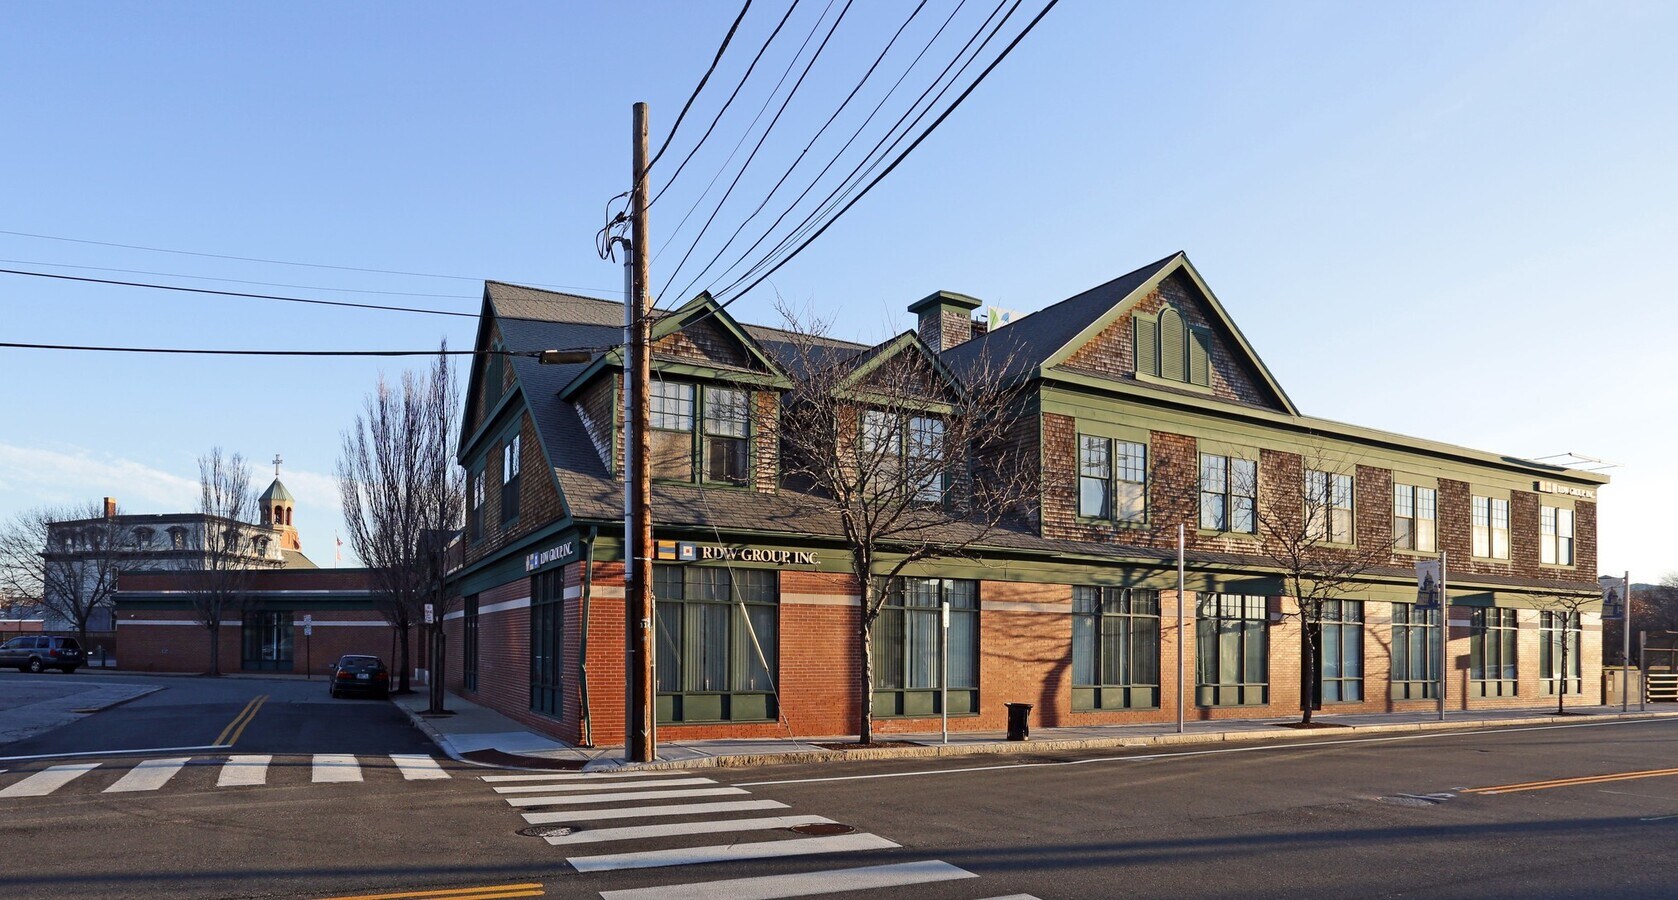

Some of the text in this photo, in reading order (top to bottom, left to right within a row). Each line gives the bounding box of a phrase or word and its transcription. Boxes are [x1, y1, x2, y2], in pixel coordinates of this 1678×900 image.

[702, 546, 821, 565] RDW GROUP, INC.
